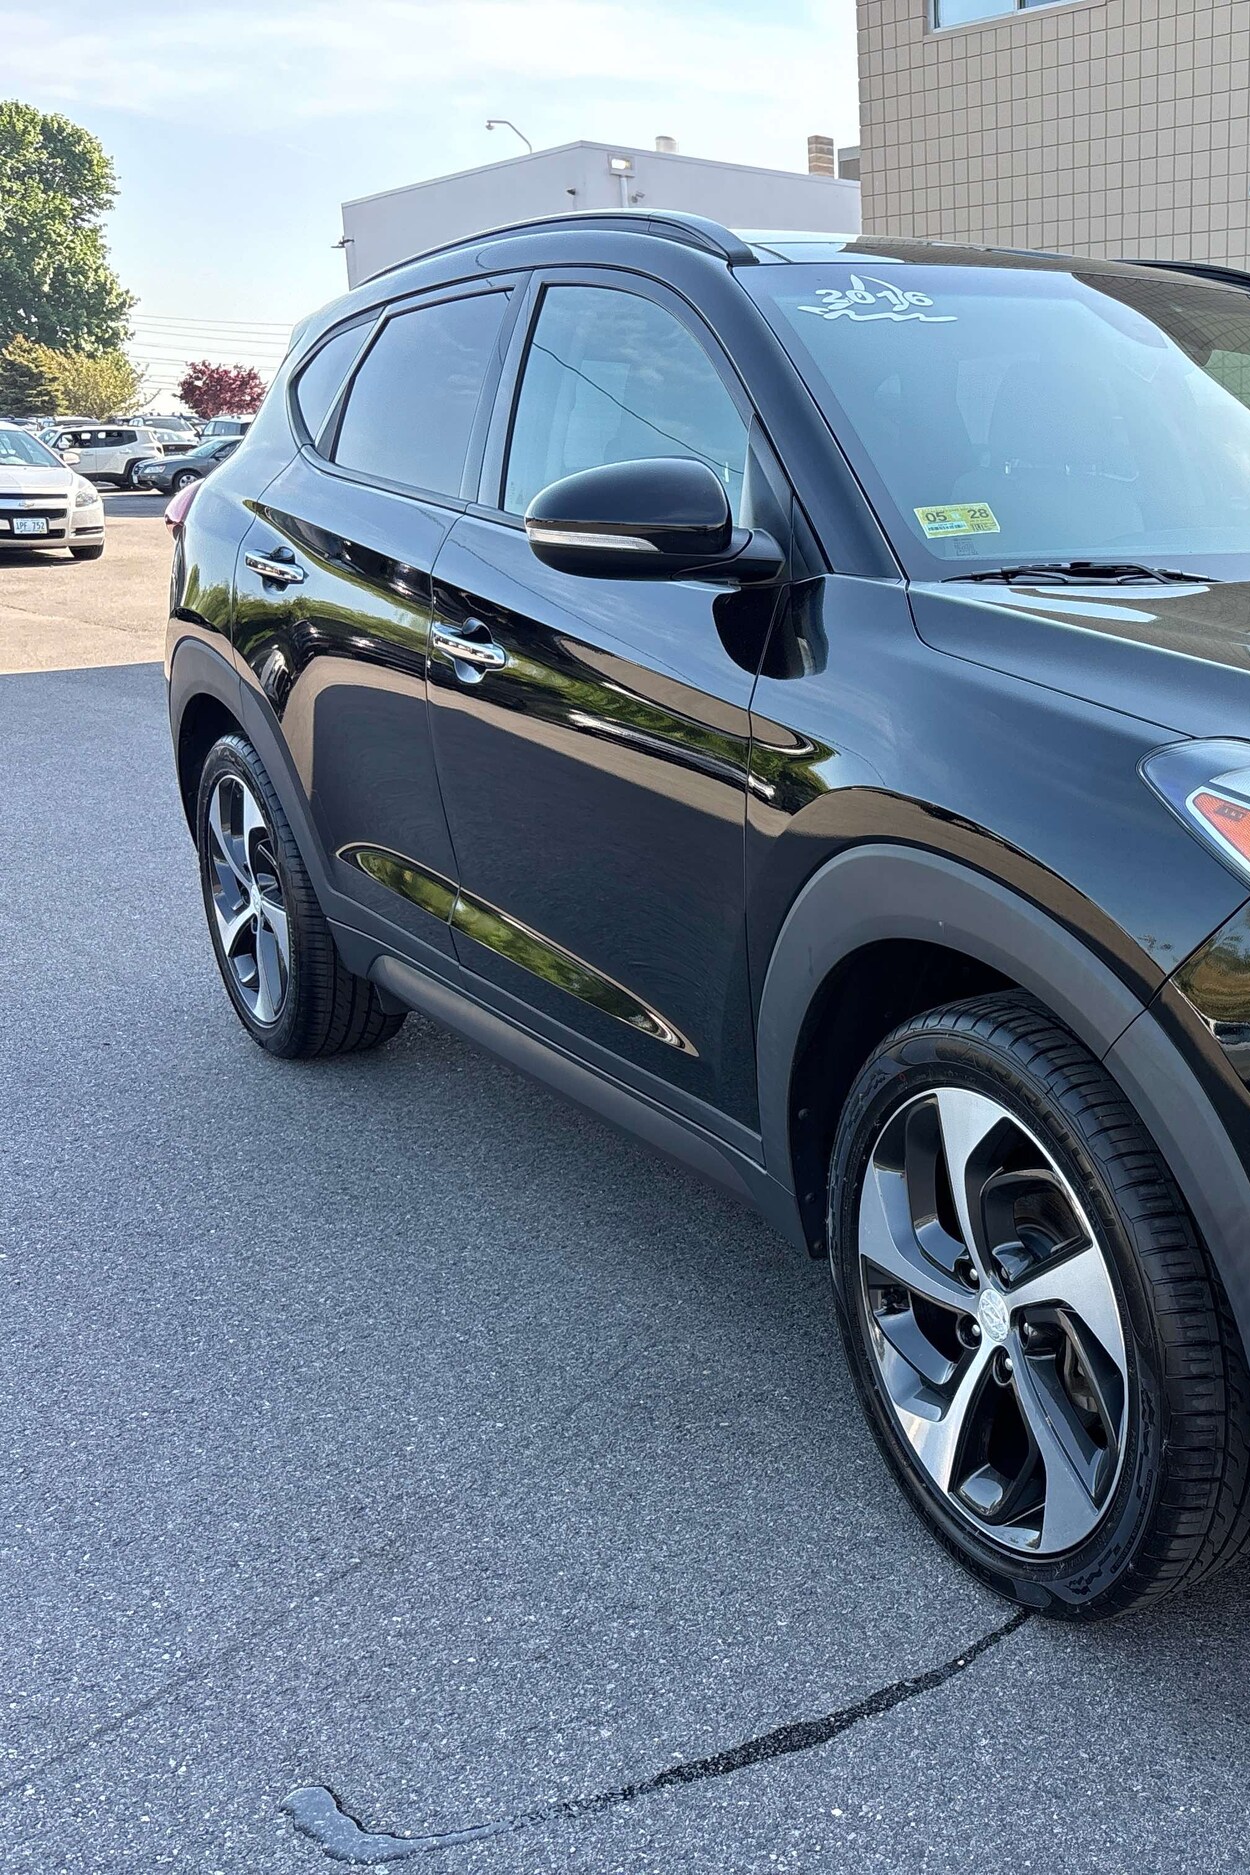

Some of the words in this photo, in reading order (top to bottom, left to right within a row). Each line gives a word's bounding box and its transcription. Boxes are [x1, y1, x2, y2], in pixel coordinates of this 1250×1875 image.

[815, 288, 934, 307] 2016
[925, 510, 948, 523] 05
[967, 508, 989, 519] 28
